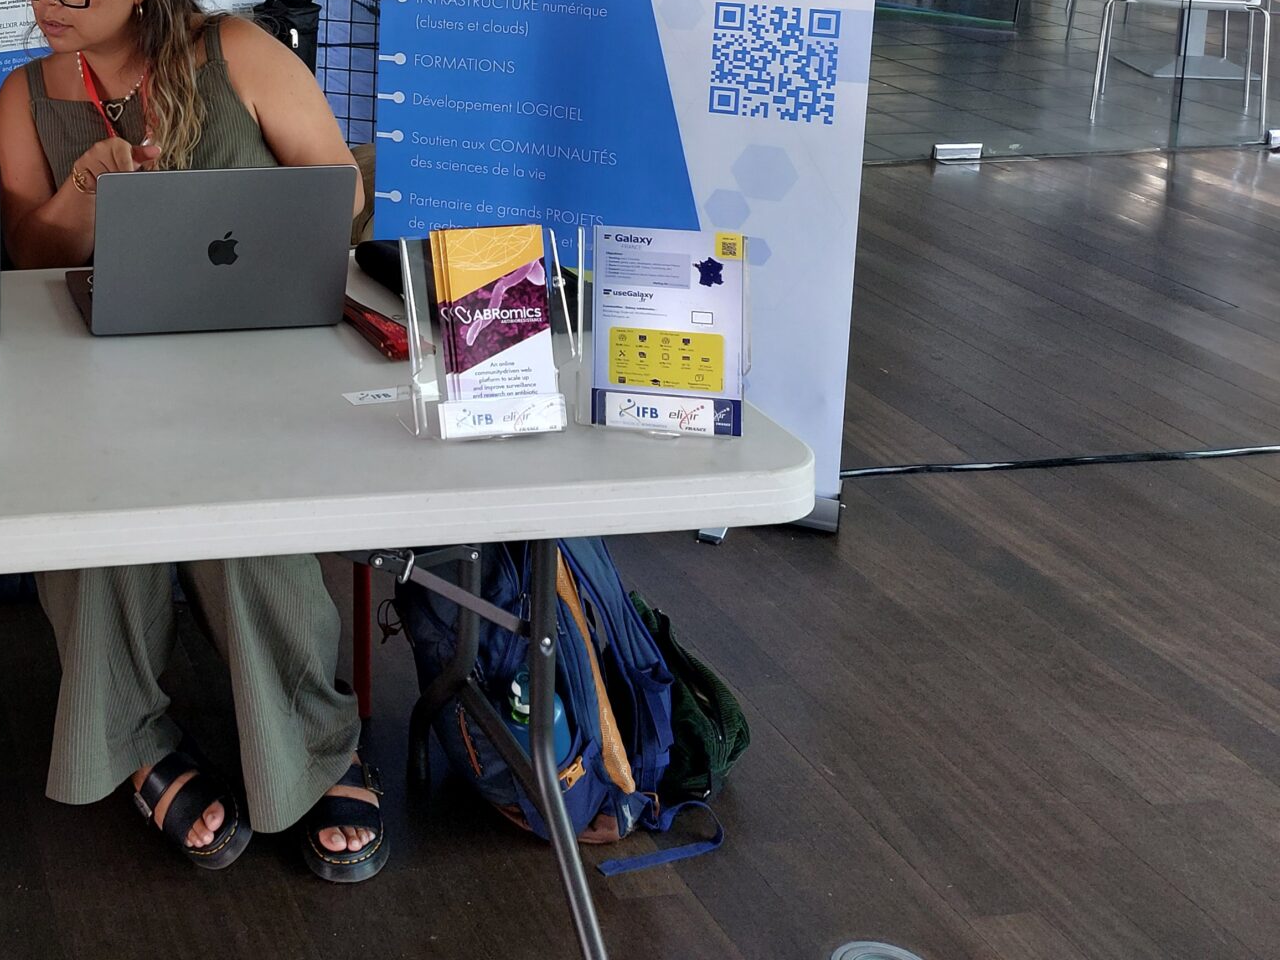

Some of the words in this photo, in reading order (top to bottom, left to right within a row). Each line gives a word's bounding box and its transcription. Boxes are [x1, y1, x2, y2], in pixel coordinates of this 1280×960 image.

[543, 2, 608, 20] numérique
[0, 22, 18, 30] ELIXIR
[416, 13, 463, 31] (clusters
[467, 20, 479, 32] et
[483, 21, 529, 37] clouds)
[414, 53, 515, 74] FORMATIONS
[412, 92, 512, 113] Développement
[516, 101, 583, 122] LOGICIEL
[411, 131, 458, 148] Soutien
[462, 139, 485, 151] aux
[489, 139, 618, 166] COMMUNAUTÉS
[410, 155, 433, 169] des
[436, 159, 489, 175] sciences
[492, 162, 509, 177] de
[513, 163, 525, 178] la
[528, 169, 546, 181] vie
[409, 192, 472, 212] Partenaire
[476, 200, 493, 214] de
[497, 203, 542, 220] grands
[546, 208, 604, 227] PROJETS
[408, 217, 425, 230] de
[561, 237, 573, 248] et
[615, 234, 653, 246] Galaxy
[613, 290, 654, 299] useGalaxy
[472, 413, 493, 425] IFB
[636, 406, 659, 419] IFB
